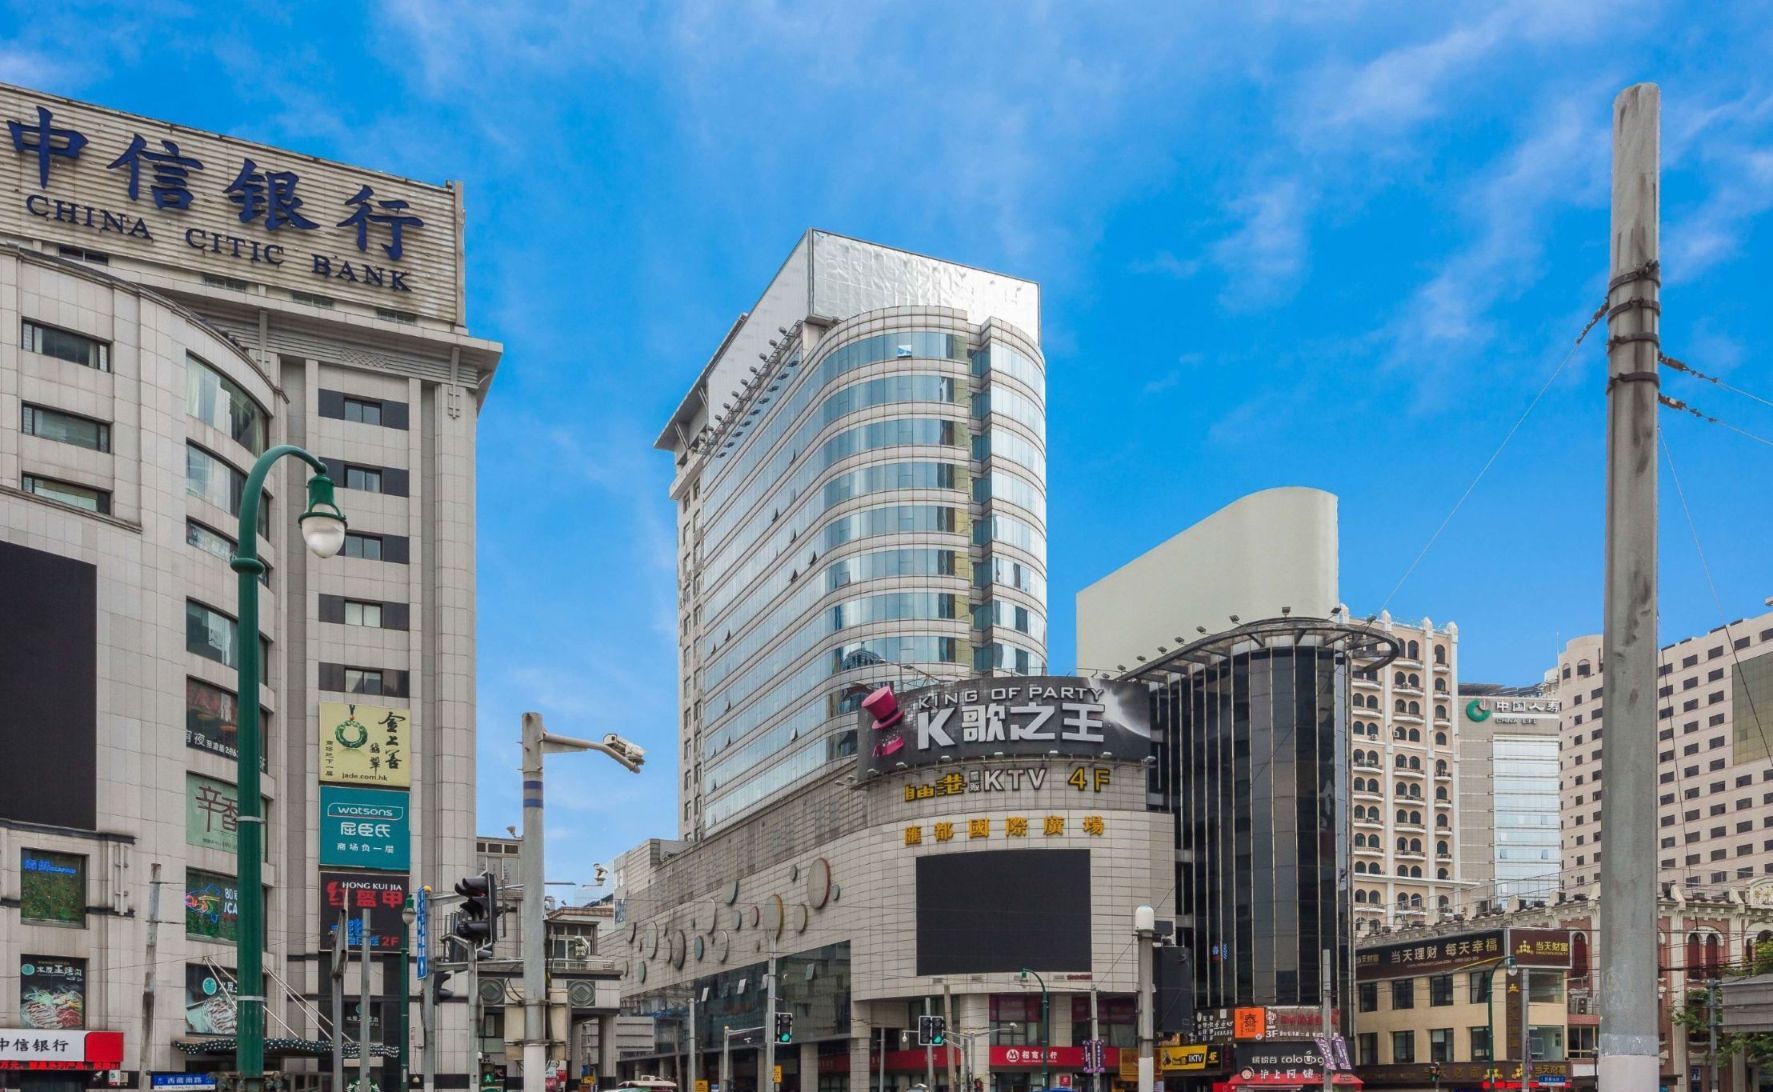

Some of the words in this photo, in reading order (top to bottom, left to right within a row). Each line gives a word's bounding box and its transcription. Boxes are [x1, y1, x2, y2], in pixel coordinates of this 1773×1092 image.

[7, 106, 424, 261] 中信银行
[26, 194, 153, 241] CHINA
[186, 228, 284, 266] CITIC
[311, 254, 412, 292] BANK
[919, 690, 978, 710] KING
[991, 686, 1018, 700] OF
[1029, 686, 1104, 701] PARTY
[1496, 700, 1559, 713] 中国人寿
[917, 702, 1105, 749] K歌之王
[378, 711, 406, 770] 金上善
[342, 772, 388, 781] jade.com.hk
[1068, 766, 1110, 793] 4F
[337, 806, 394, 817] watsons
[340, 822, 391, 838] 屈臣氏
[337, 842, 394, 854] 商场负一层
[341, 881, 370, 889] HONG
[372, 882, 388, 890] KUI
[390, 883, 402, 891] JIA
[382, 936, 399, 946] 2F
[1535, 941, 1569, 953] 当天财富
[1391, 945, 1437, 963] 当天理财
[1445, 937, 1498, 956] 每天幸福
[1022, 1051, 1058, 1060] 招商行
